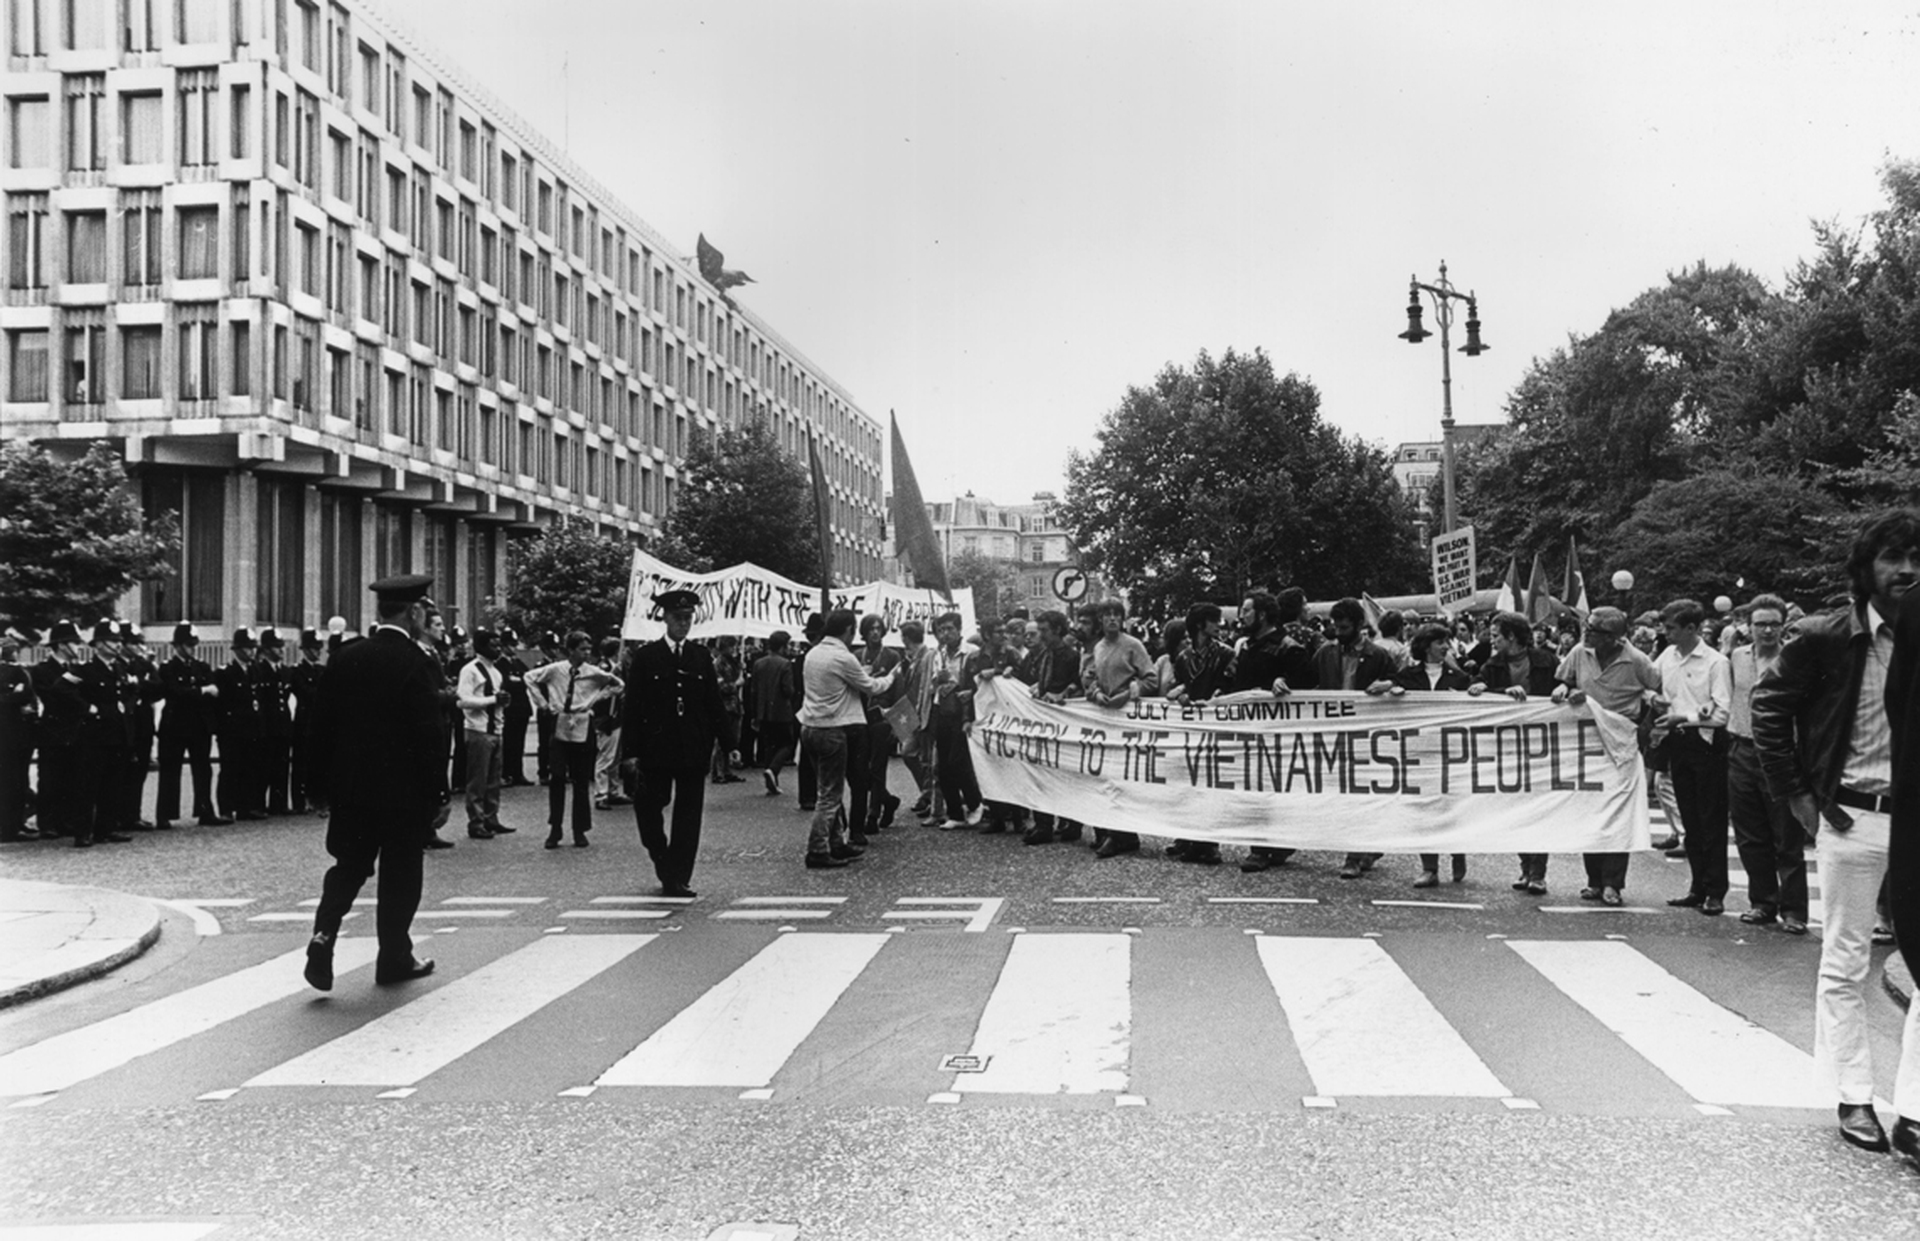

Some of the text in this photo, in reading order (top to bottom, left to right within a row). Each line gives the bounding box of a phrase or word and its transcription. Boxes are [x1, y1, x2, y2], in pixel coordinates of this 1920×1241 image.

[1438, 548, 1468, 564] WE WANT
[1438, 565, 1445, 573] NO
[1453, 567, 1470, 580] WAR
[1441, 577, 1469, 593] AGAINST
[725, 577, 770, 622] WITH
[775, 586, 811, 626] THE
[1127, 701, 1168, 720] JULY
[1215, 701, 1356, 721] COMMITTEE
[978, 712, 1605, 795] VICTORY TO THE VIETNAMESE PEOPLE
